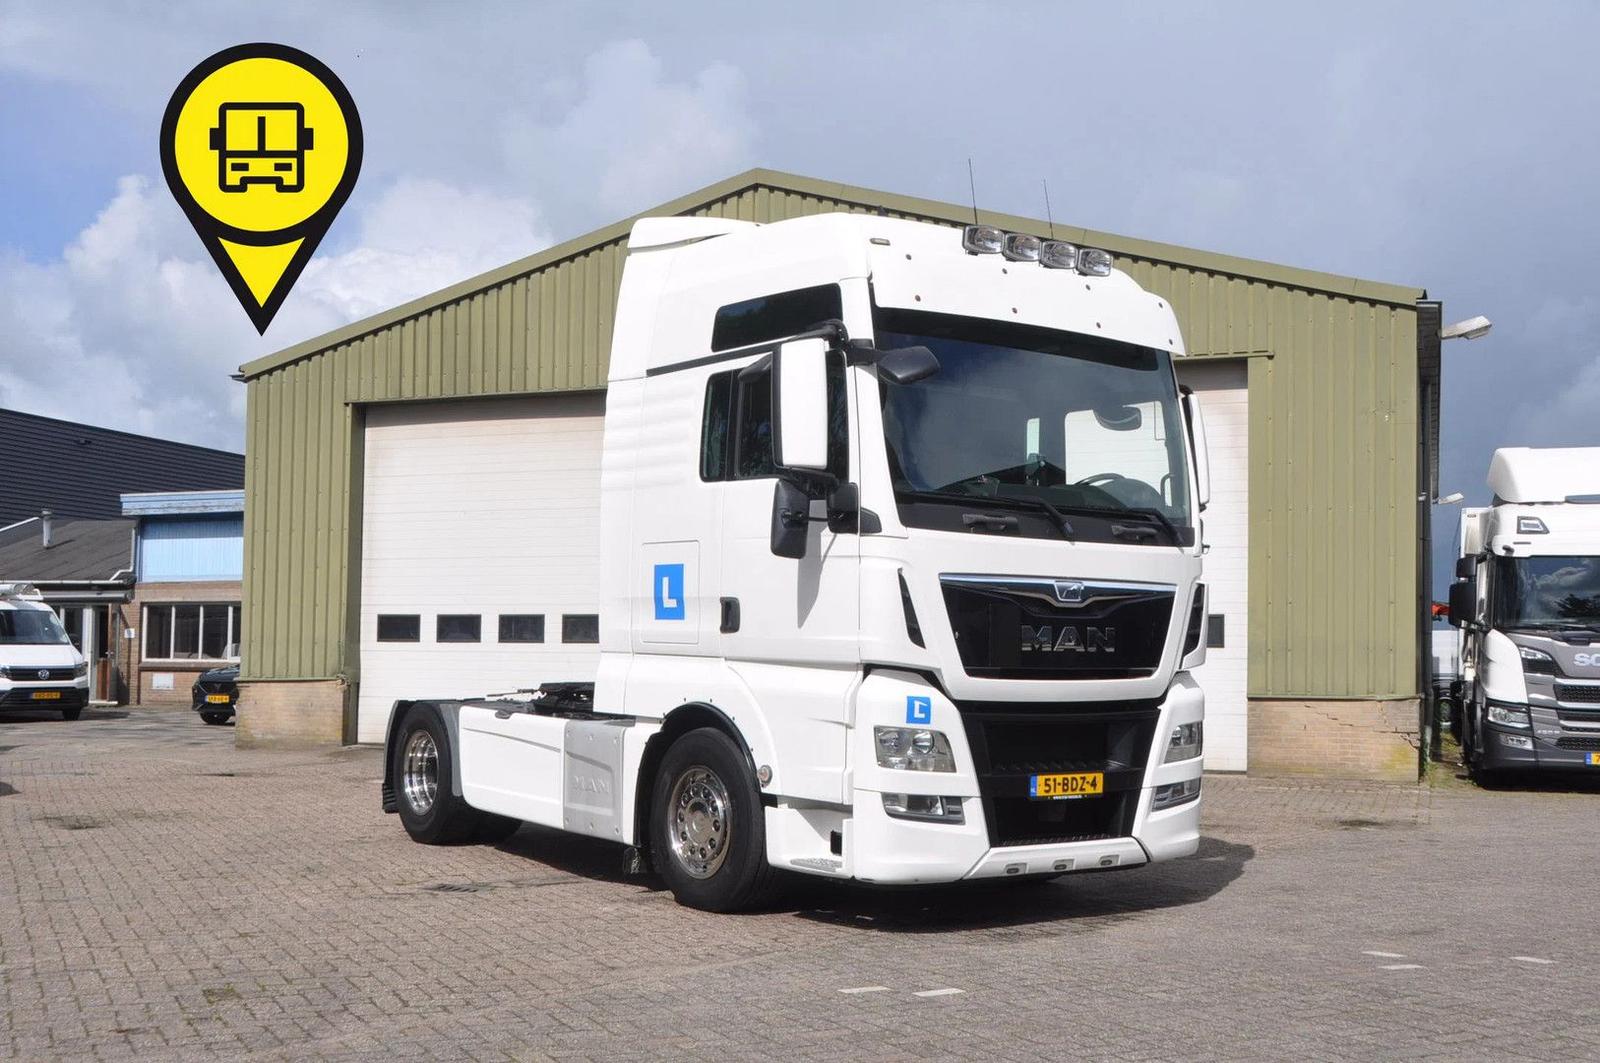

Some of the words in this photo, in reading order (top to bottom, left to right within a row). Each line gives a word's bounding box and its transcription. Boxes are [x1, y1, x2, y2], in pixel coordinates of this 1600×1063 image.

[662, 576, 677, 608] L
[1021, 625, 1115, 652] MAN
[1044, 776, 1097, 793] 51-BDZ-4
